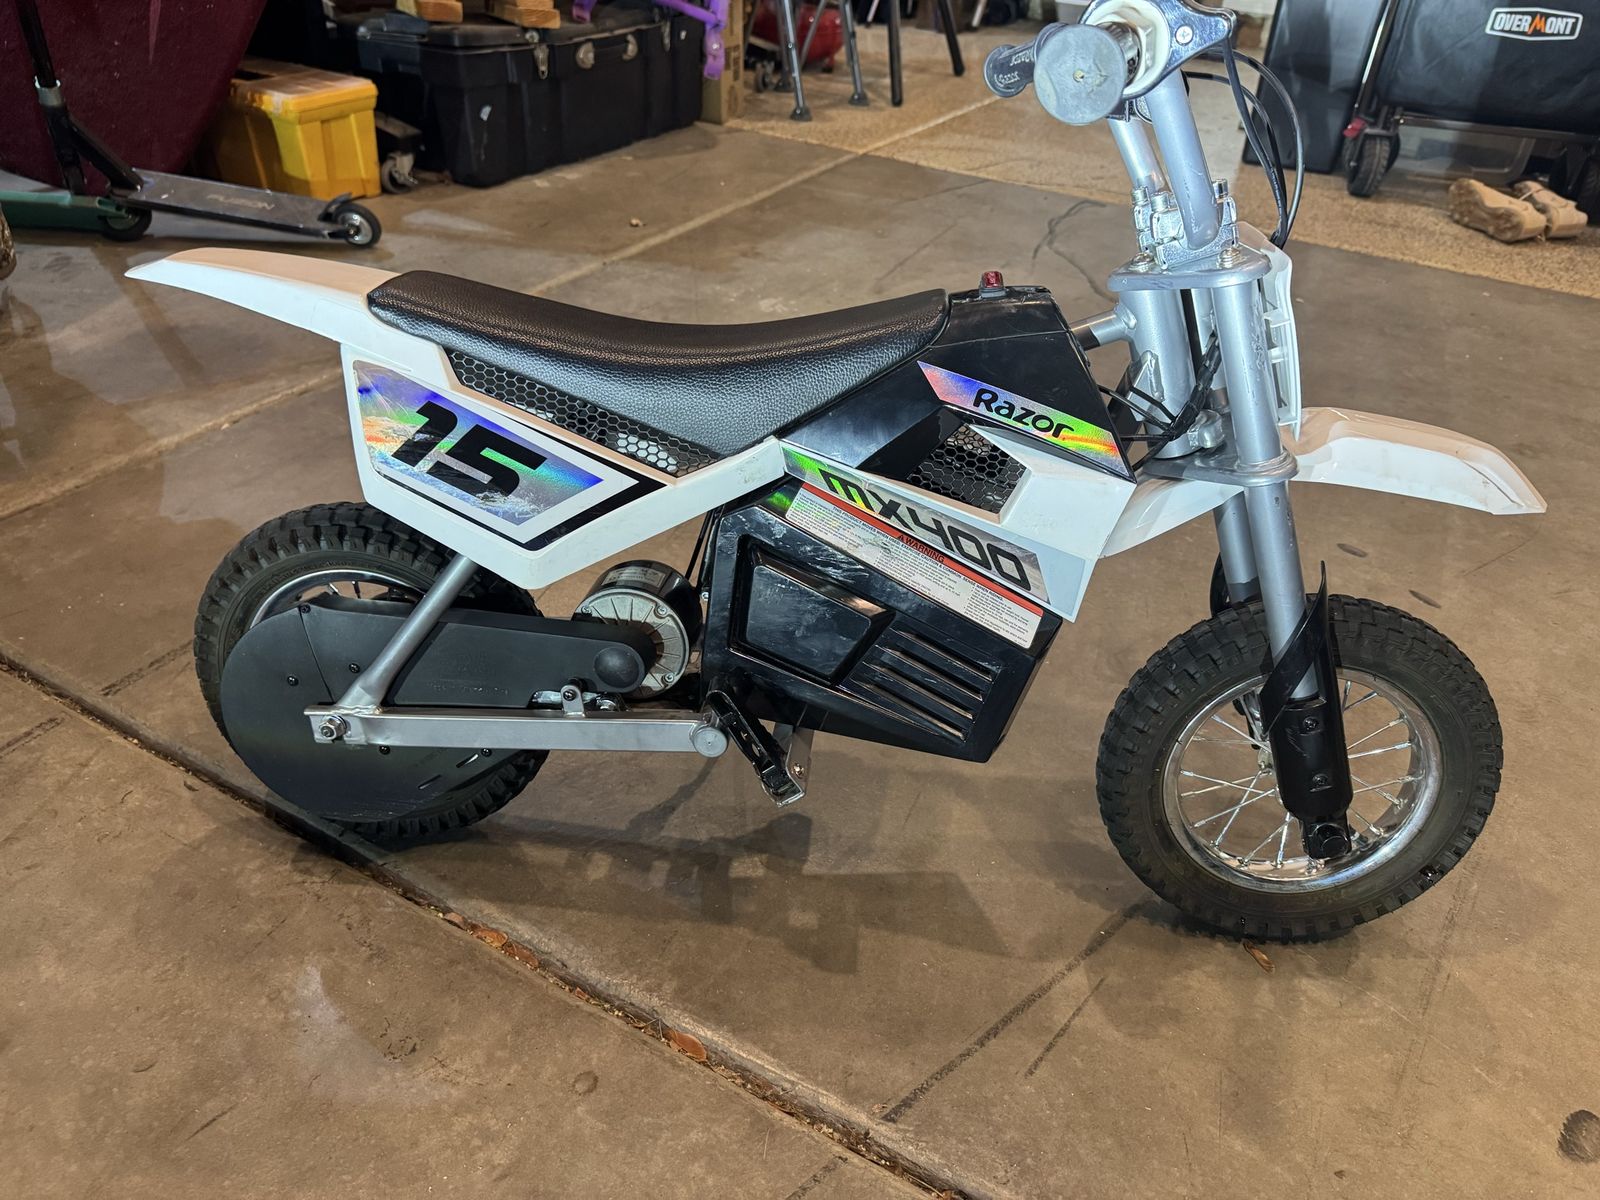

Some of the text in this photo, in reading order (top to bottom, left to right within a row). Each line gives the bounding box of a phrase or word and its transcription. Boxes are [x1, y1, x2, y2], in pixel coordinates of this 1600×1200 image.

[1493, 12, 1577, 35] OVERMONT
[972, 387, 1075, 438] Razor
[391, 400, 548, 497] 15
[841, 511, 862, 524] PRODUCT
[861, 521, 876, 532] MOVES
[875, 529, 889, 539] WHEN
[904, 536, 945, 563] WARNING
